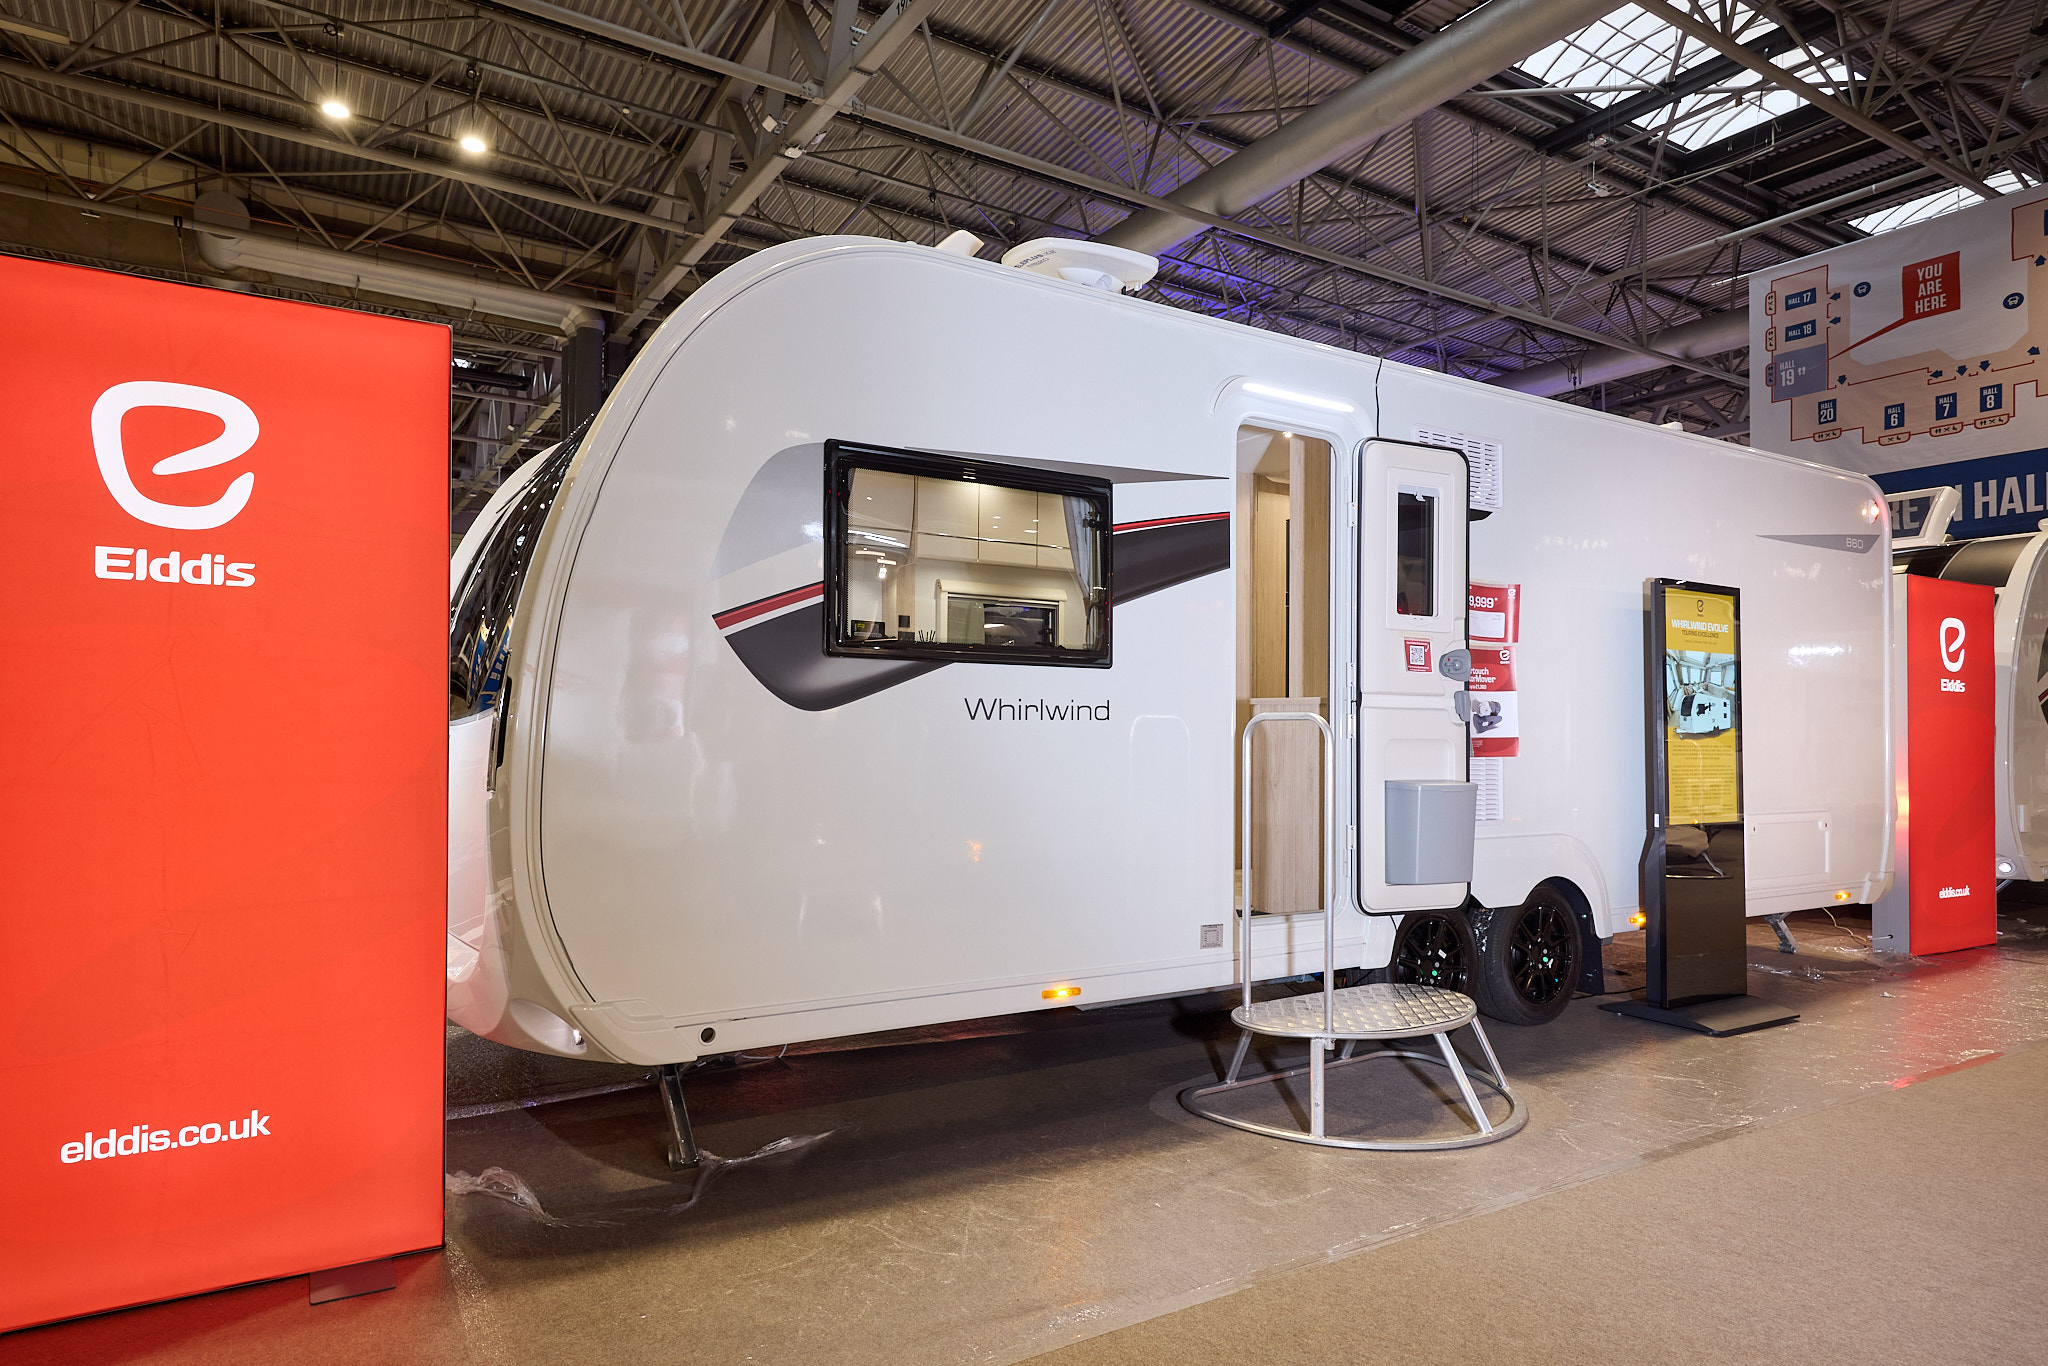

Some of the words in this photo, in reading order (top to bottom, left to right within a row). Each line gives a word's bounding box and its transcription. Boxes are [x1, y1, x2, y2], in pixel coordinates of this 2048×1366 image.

[1916, 262, 1942, 281] YOU
[1918, 278, 1942, 298] ARE
[1787, 297, 1801, 305] HALL
[1803, 292, 1812, 303] 17
[1915, 296, 1947, 314] HERE
[1788, 328, 1801, 337] HALL
[1803, 324, 1812, 335] 18
[1779, 360, 1796, 370] HALL
[1780, 370, 1795, 387] 19
[1982, 386, 1998, 396] HALL
[1820, 401, 1833, 410] HALL
[1938, 396, 1954, 404] HALL
[1986, 395, 1995, 409] 8
[1820, 409, 1834, 422] 20
[1887, 406, 1901, 415] HALL
[1943, 403, 1950, 417] 7
[1890, 413, 1899, 427] 6
[1974, 472, 2048, 520] HAL
[94, 545, 256, 587] Elddis
[1671, 618, 1707, 631] WHIRLWIND
[1707, 622, 1729, 633] EVOLVE
[1940, 678, 1965, 692] Elddis
[964, 697, 1111, 722] Whirlwind
[1939, 885, 1970, 899] elddis.co.uk
[60, 1109, 272, 1164] elddis.co.uk
